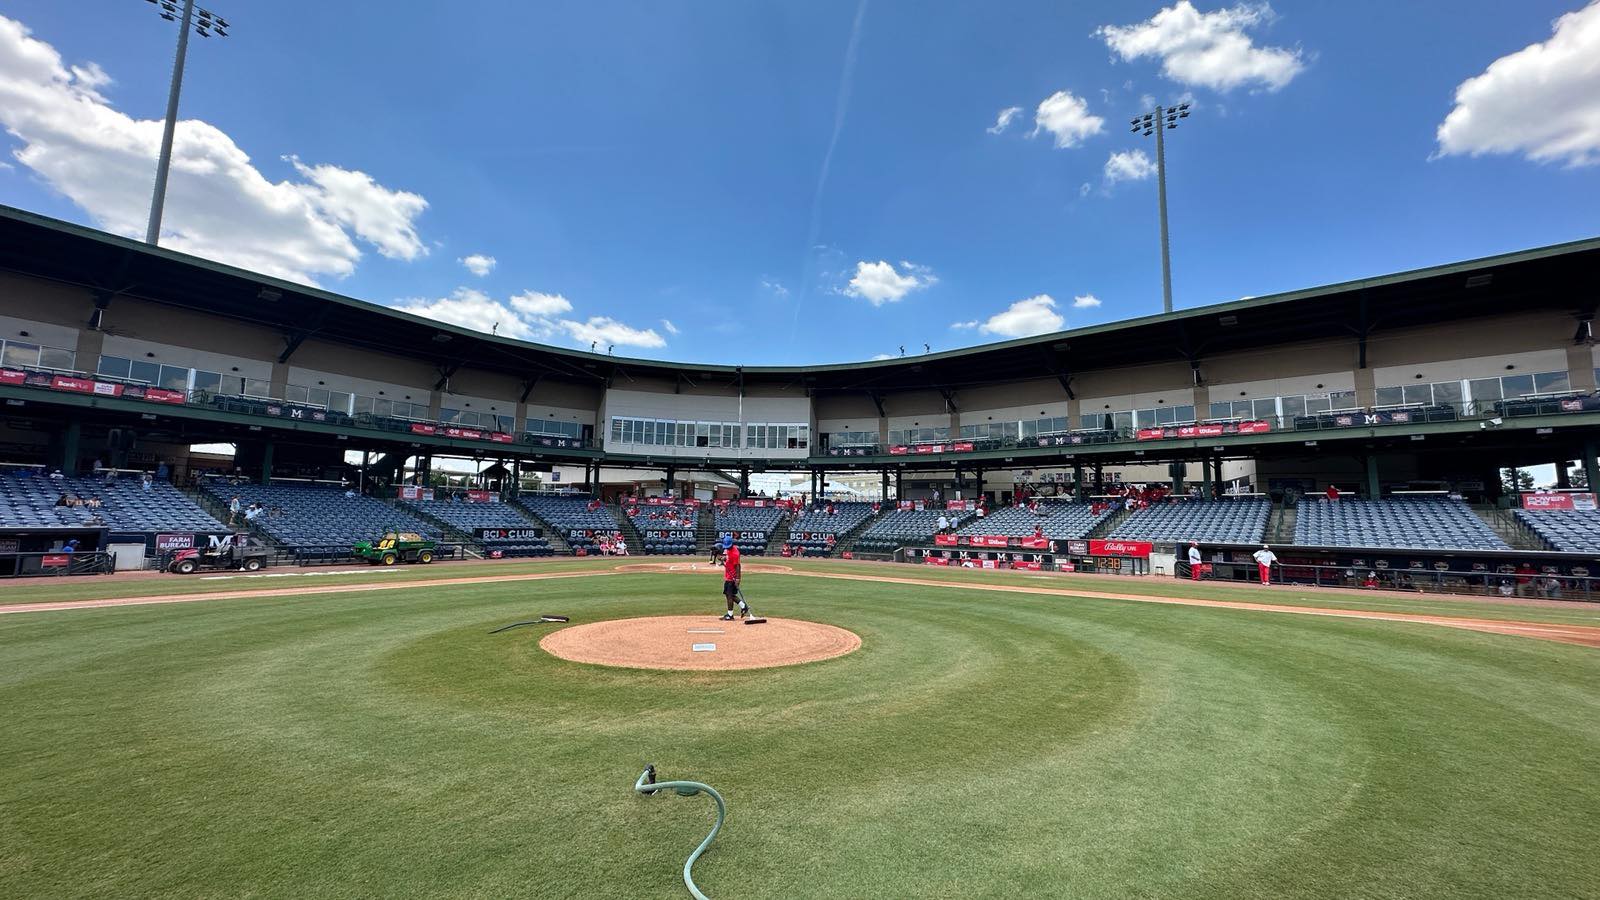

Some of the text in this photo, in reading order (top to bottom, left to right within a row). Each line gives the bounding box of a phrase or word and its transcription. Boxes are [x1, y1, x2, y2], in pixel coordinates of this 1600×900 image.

[291, 408, 304, 419] M
[1364, 414, 1378, 424] M
[557, 439, 566, 447] M
[1055, 437, 1065, 445] M
[483, 529, 535, 539] BCI CLUB
[570, 529, 587, 538] BCI
[646, 530, 694, 539] BCI CLUB
[740, 531, 765, 540] CLUB
[790, 532, 805, 541] BCI
[159, 542, 191, 550] BUREAU
[1104, 542, 1127, 554] Bally
[922, 549, 931, 558] M
[960, 551, 968, 559] M
[997, 553, 1006, 562] M
[1033, 554, 1042, 563] M
